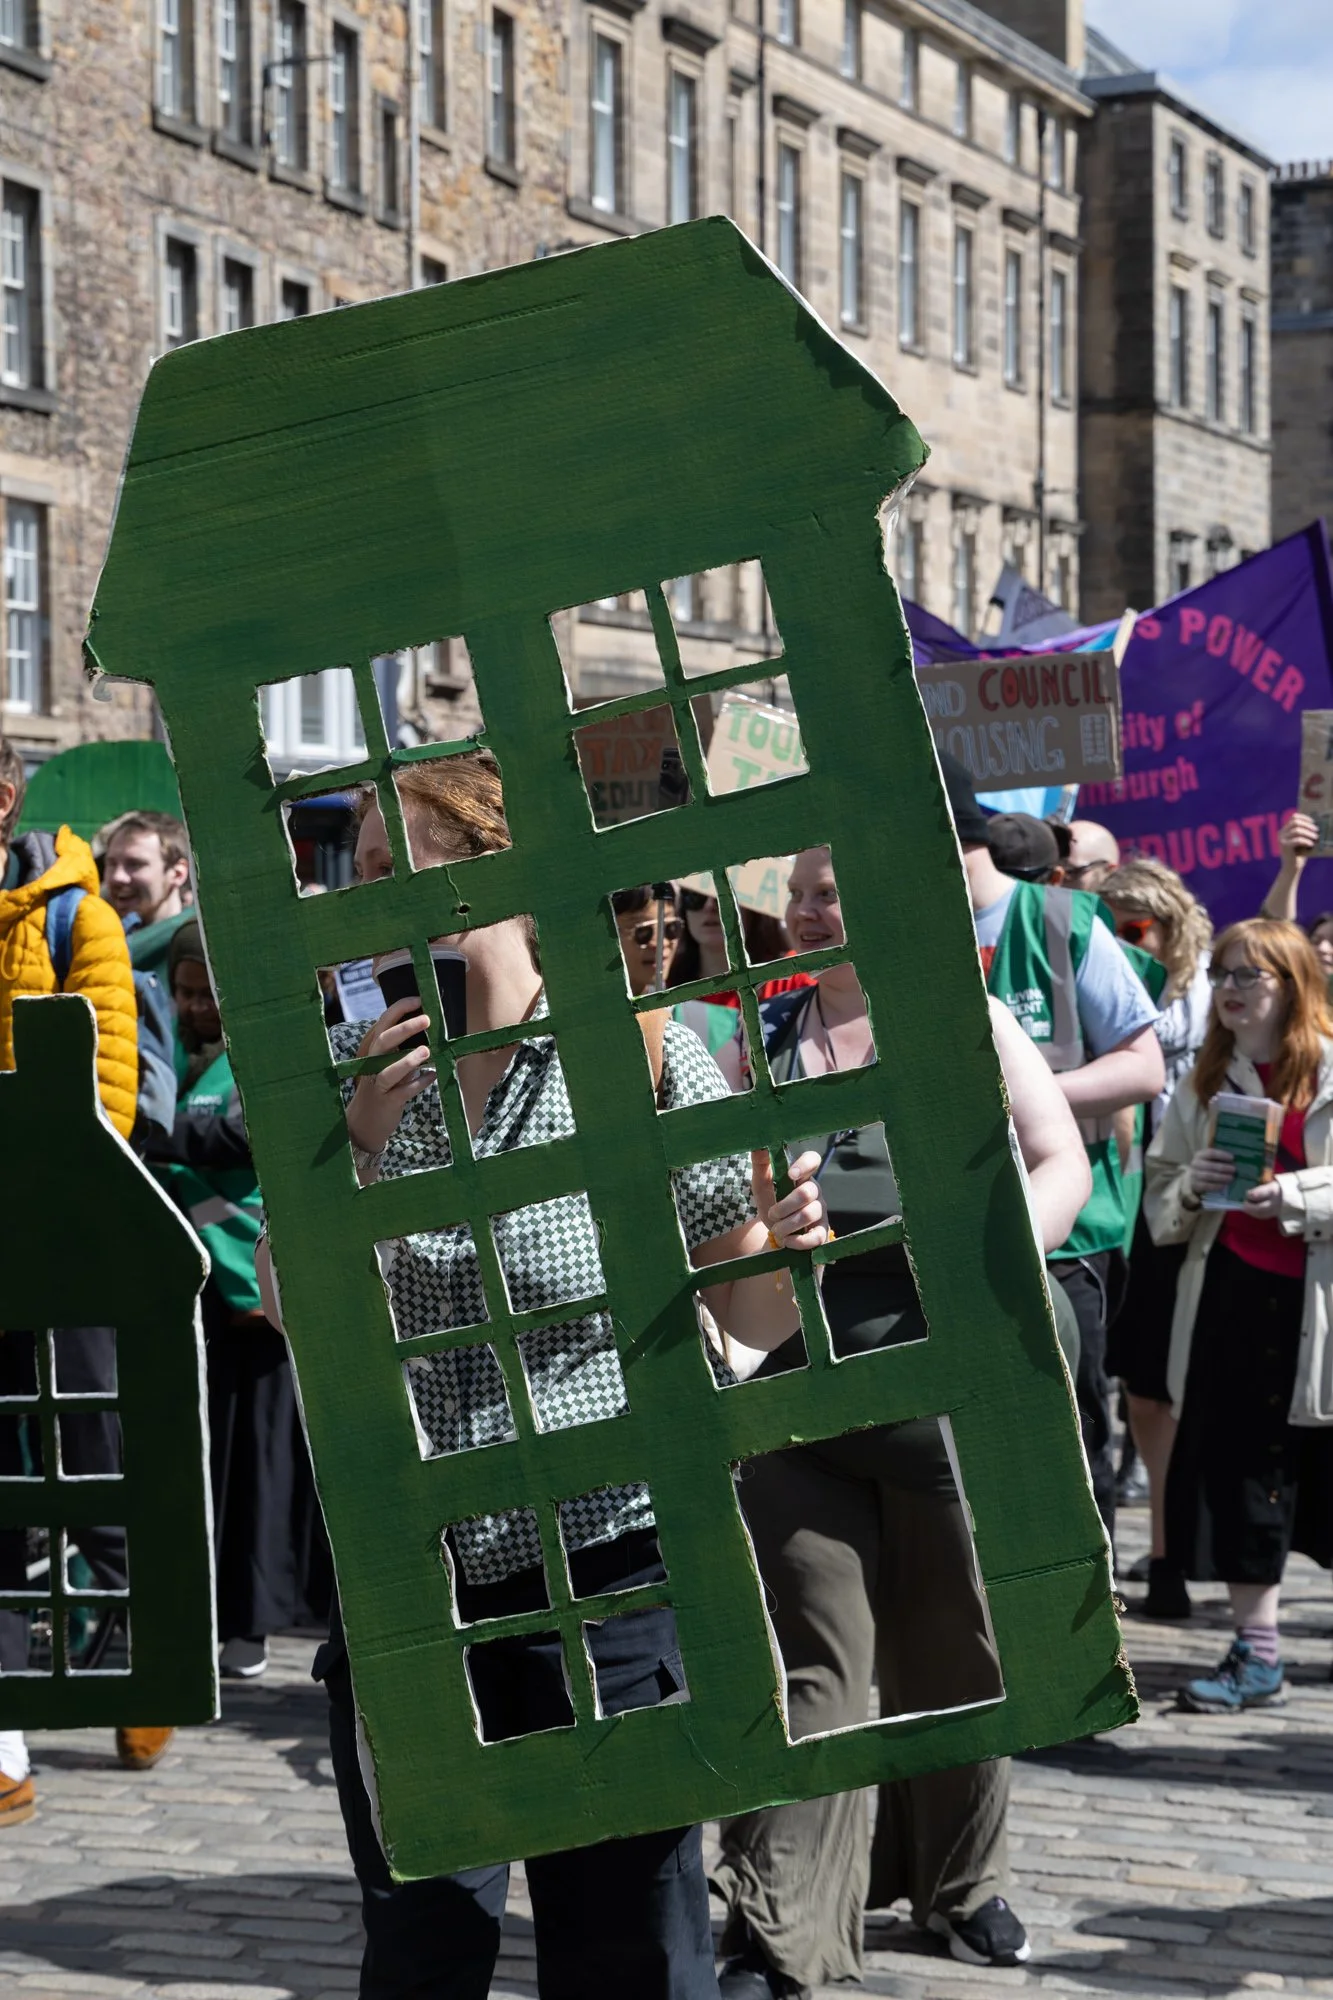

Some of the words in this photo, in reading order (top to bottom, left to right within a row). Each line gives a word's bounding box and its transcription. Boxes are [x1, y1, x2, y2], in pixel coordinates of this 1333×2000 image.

[1179, 607, 1305, 713] POWER
[978, 660, 1112, 711] COUNCIL
[1175, 700, 1203, 739] of
[582, 737, 662, 775] TAX
